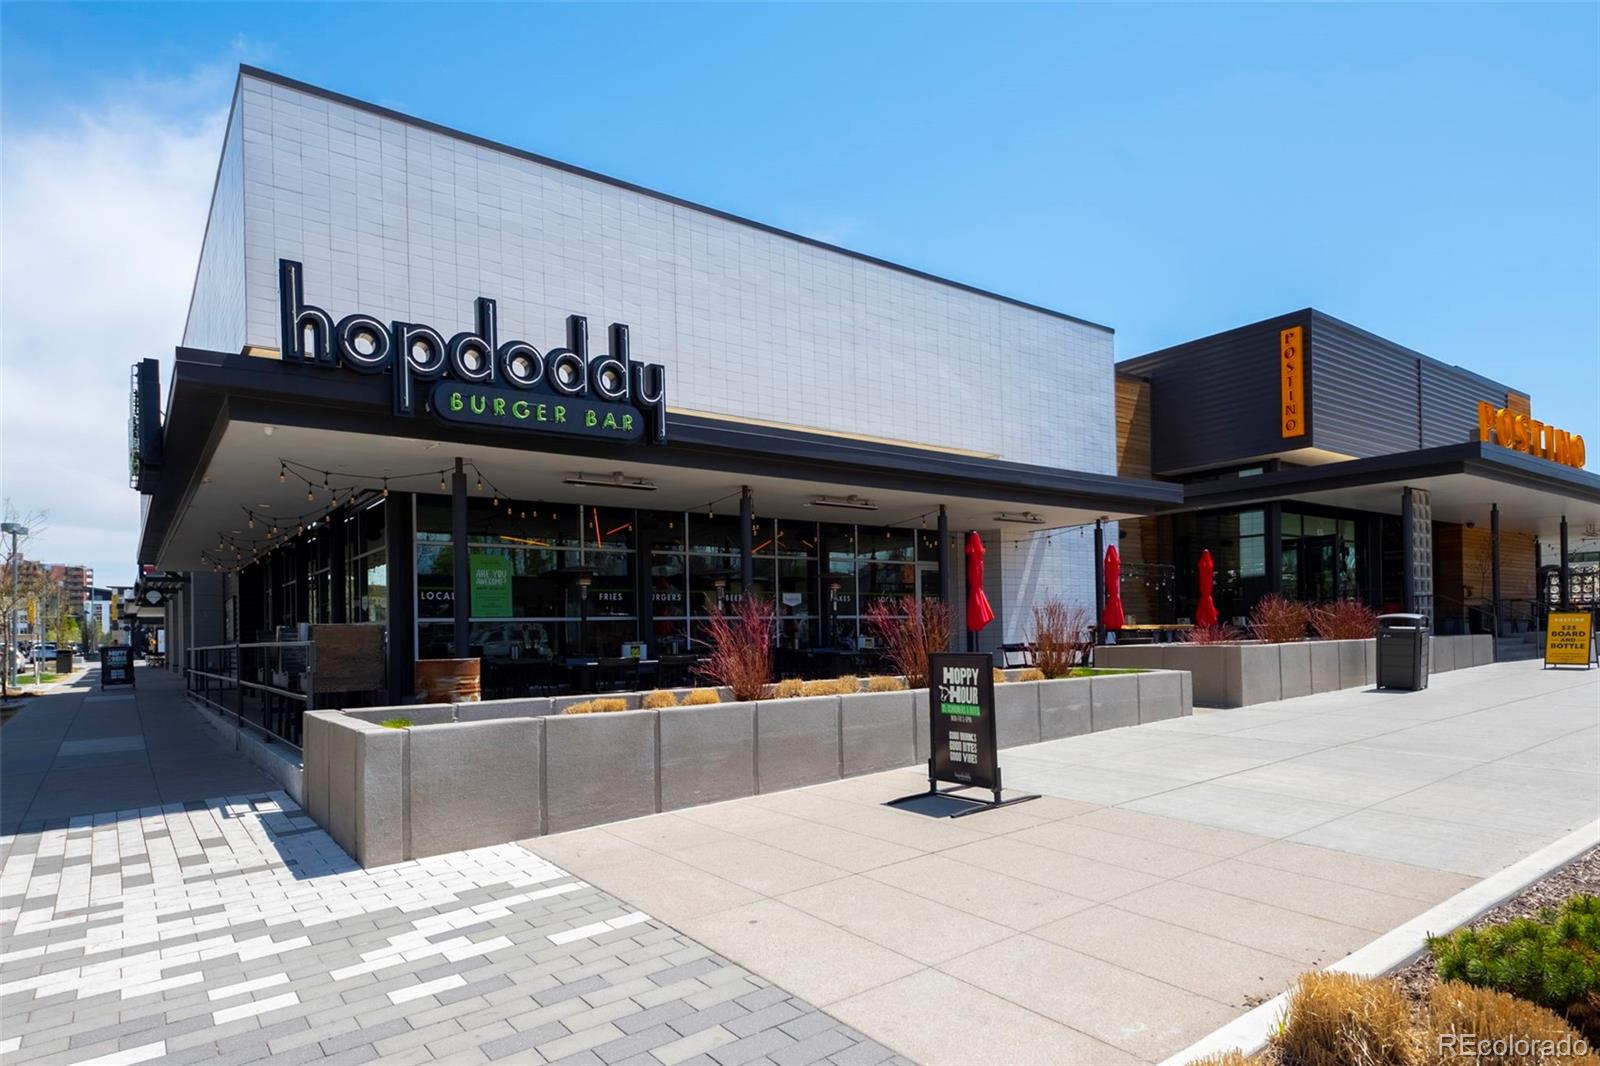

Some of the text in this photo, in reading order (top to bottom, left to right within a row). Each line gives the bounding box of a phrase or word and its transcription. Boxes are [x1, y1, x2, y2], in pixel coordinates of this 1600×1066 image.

[279, 258, 667, 445] hopdoddy
[1284, 332, 1297, 431] POSTINO
[450, 392, 634, 432] BURGER BAR
[1477, 400, 1586, 470] POSTINO
[475, 568, 507, 578] ARE YOU
[598, 592, 623, 601] FRIES
[943, 667, 979, 685] HOPPY
[950, 686, 979, 704] HOUR
